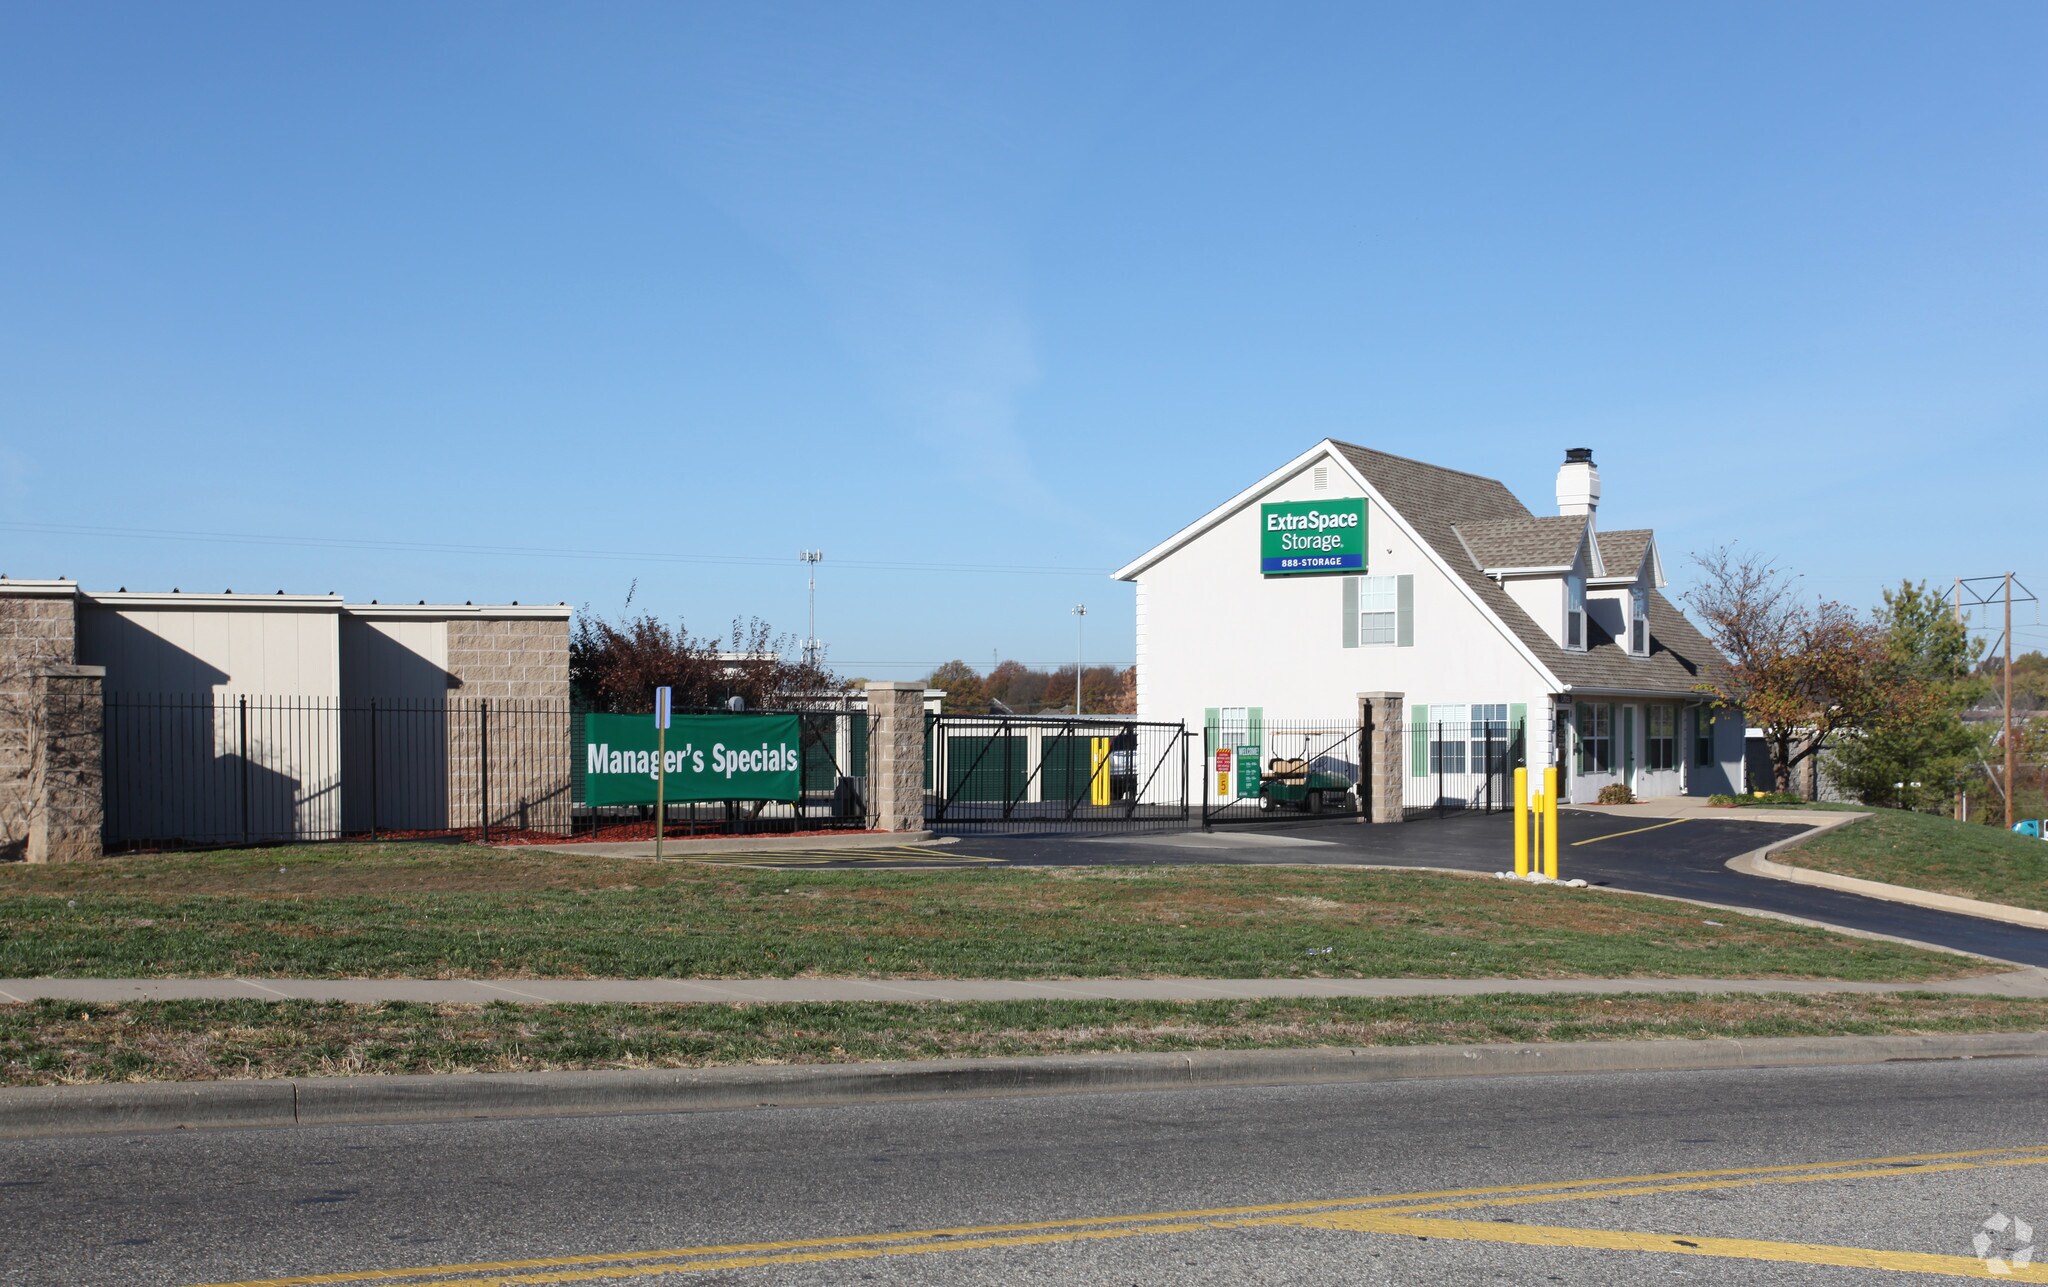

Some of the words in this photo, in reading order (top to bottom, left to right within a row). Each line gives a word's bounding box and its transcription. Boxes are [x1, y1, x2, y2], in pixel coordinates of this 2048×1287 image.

[1267, 510, 1358, 533] ExtraSpace
[1281, 557, 1342, 567] 888-STORAGE
[587, 743, 705, 781] Manager's
[712, 742, 798, 779] Specials
[1221, 780, 1226, 791] 5
